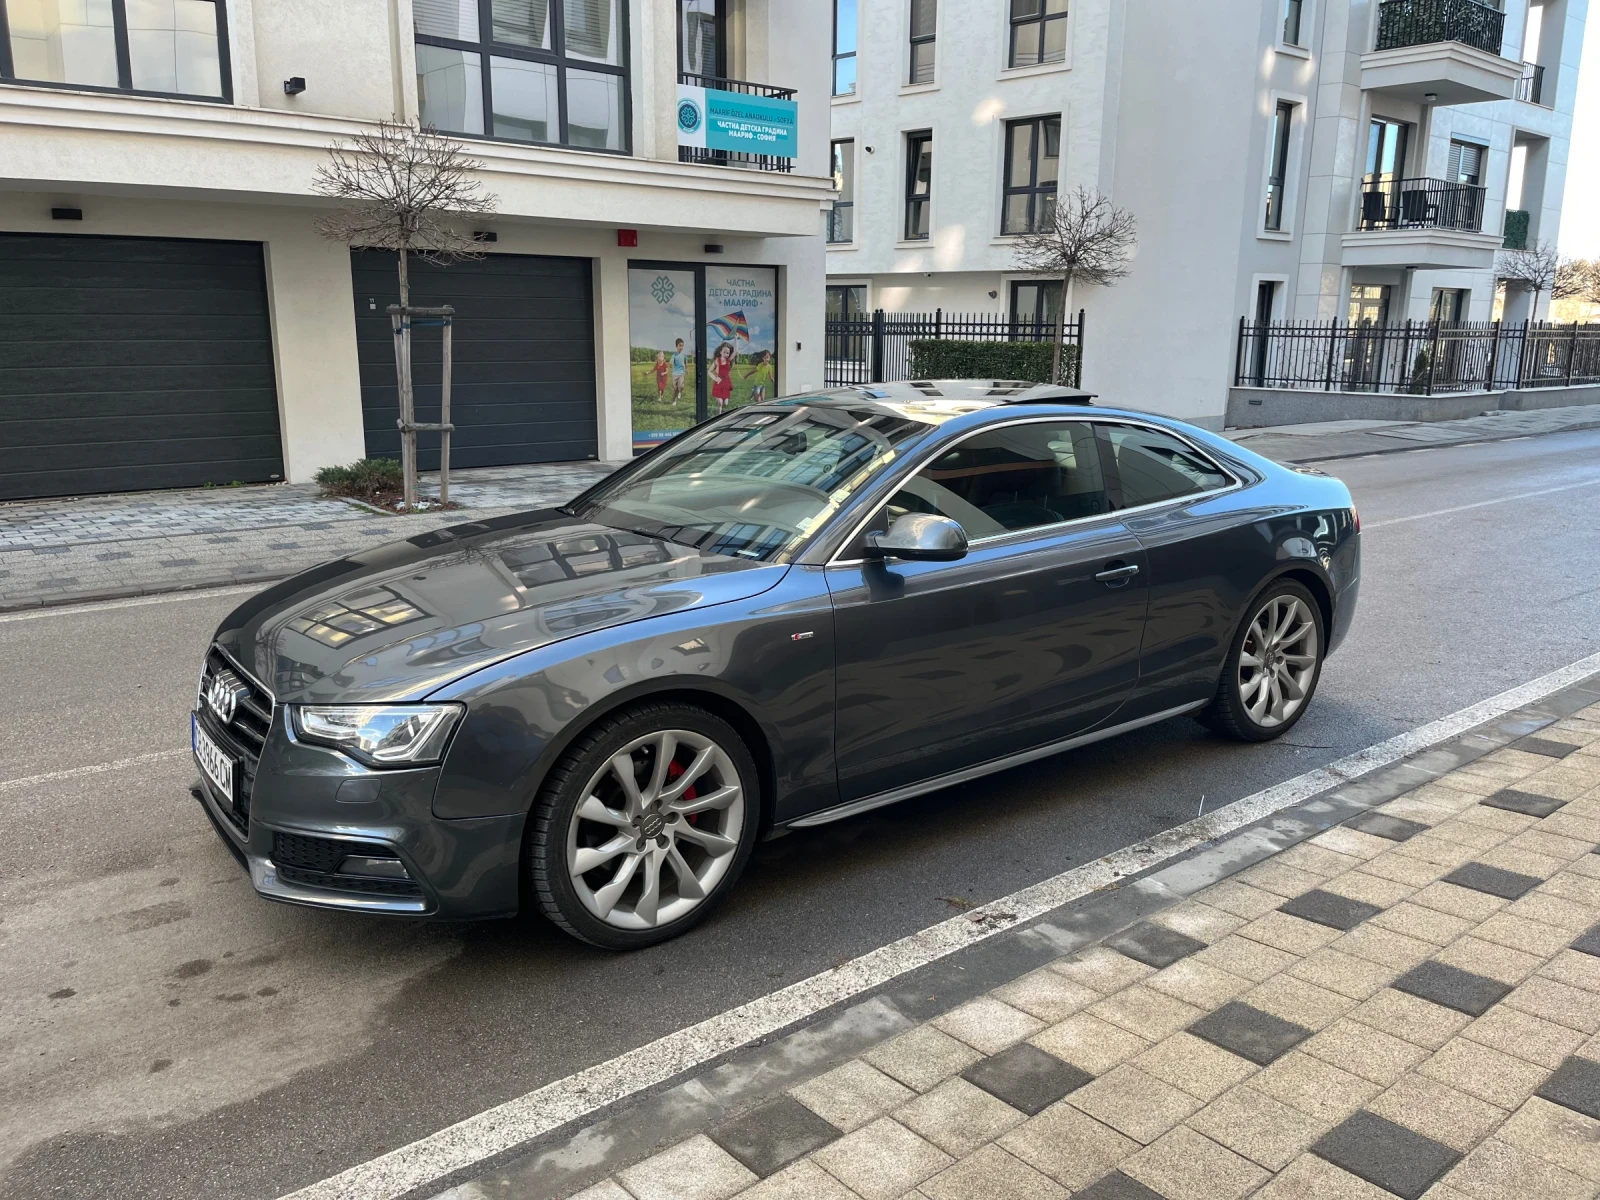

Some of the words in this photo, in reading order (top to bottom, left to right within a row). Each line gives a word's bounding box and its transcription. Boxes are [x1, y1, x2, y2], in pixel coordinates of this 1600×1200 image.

[731, 110, 744, 118] ÖZEL
[745, 112, 773, 122] ANAOKULU
[717, 120, 740, 130] ЧАСТНА
[740, 123, 761, 133] ДЕТСКА
[762, 126, 788, 136] ГРАДИНА
[728, 130, 753, 140] МААРИФ
[757, 133, 777, 142] СОФИЯ
[726, 279, 755, 287] ЧАСТНА
[709, 288, 737, 298] ДЕТСКА
[739, 289, 772, 298] ГРАДИНА
[723, 298, 759, 308] МААРИФ
